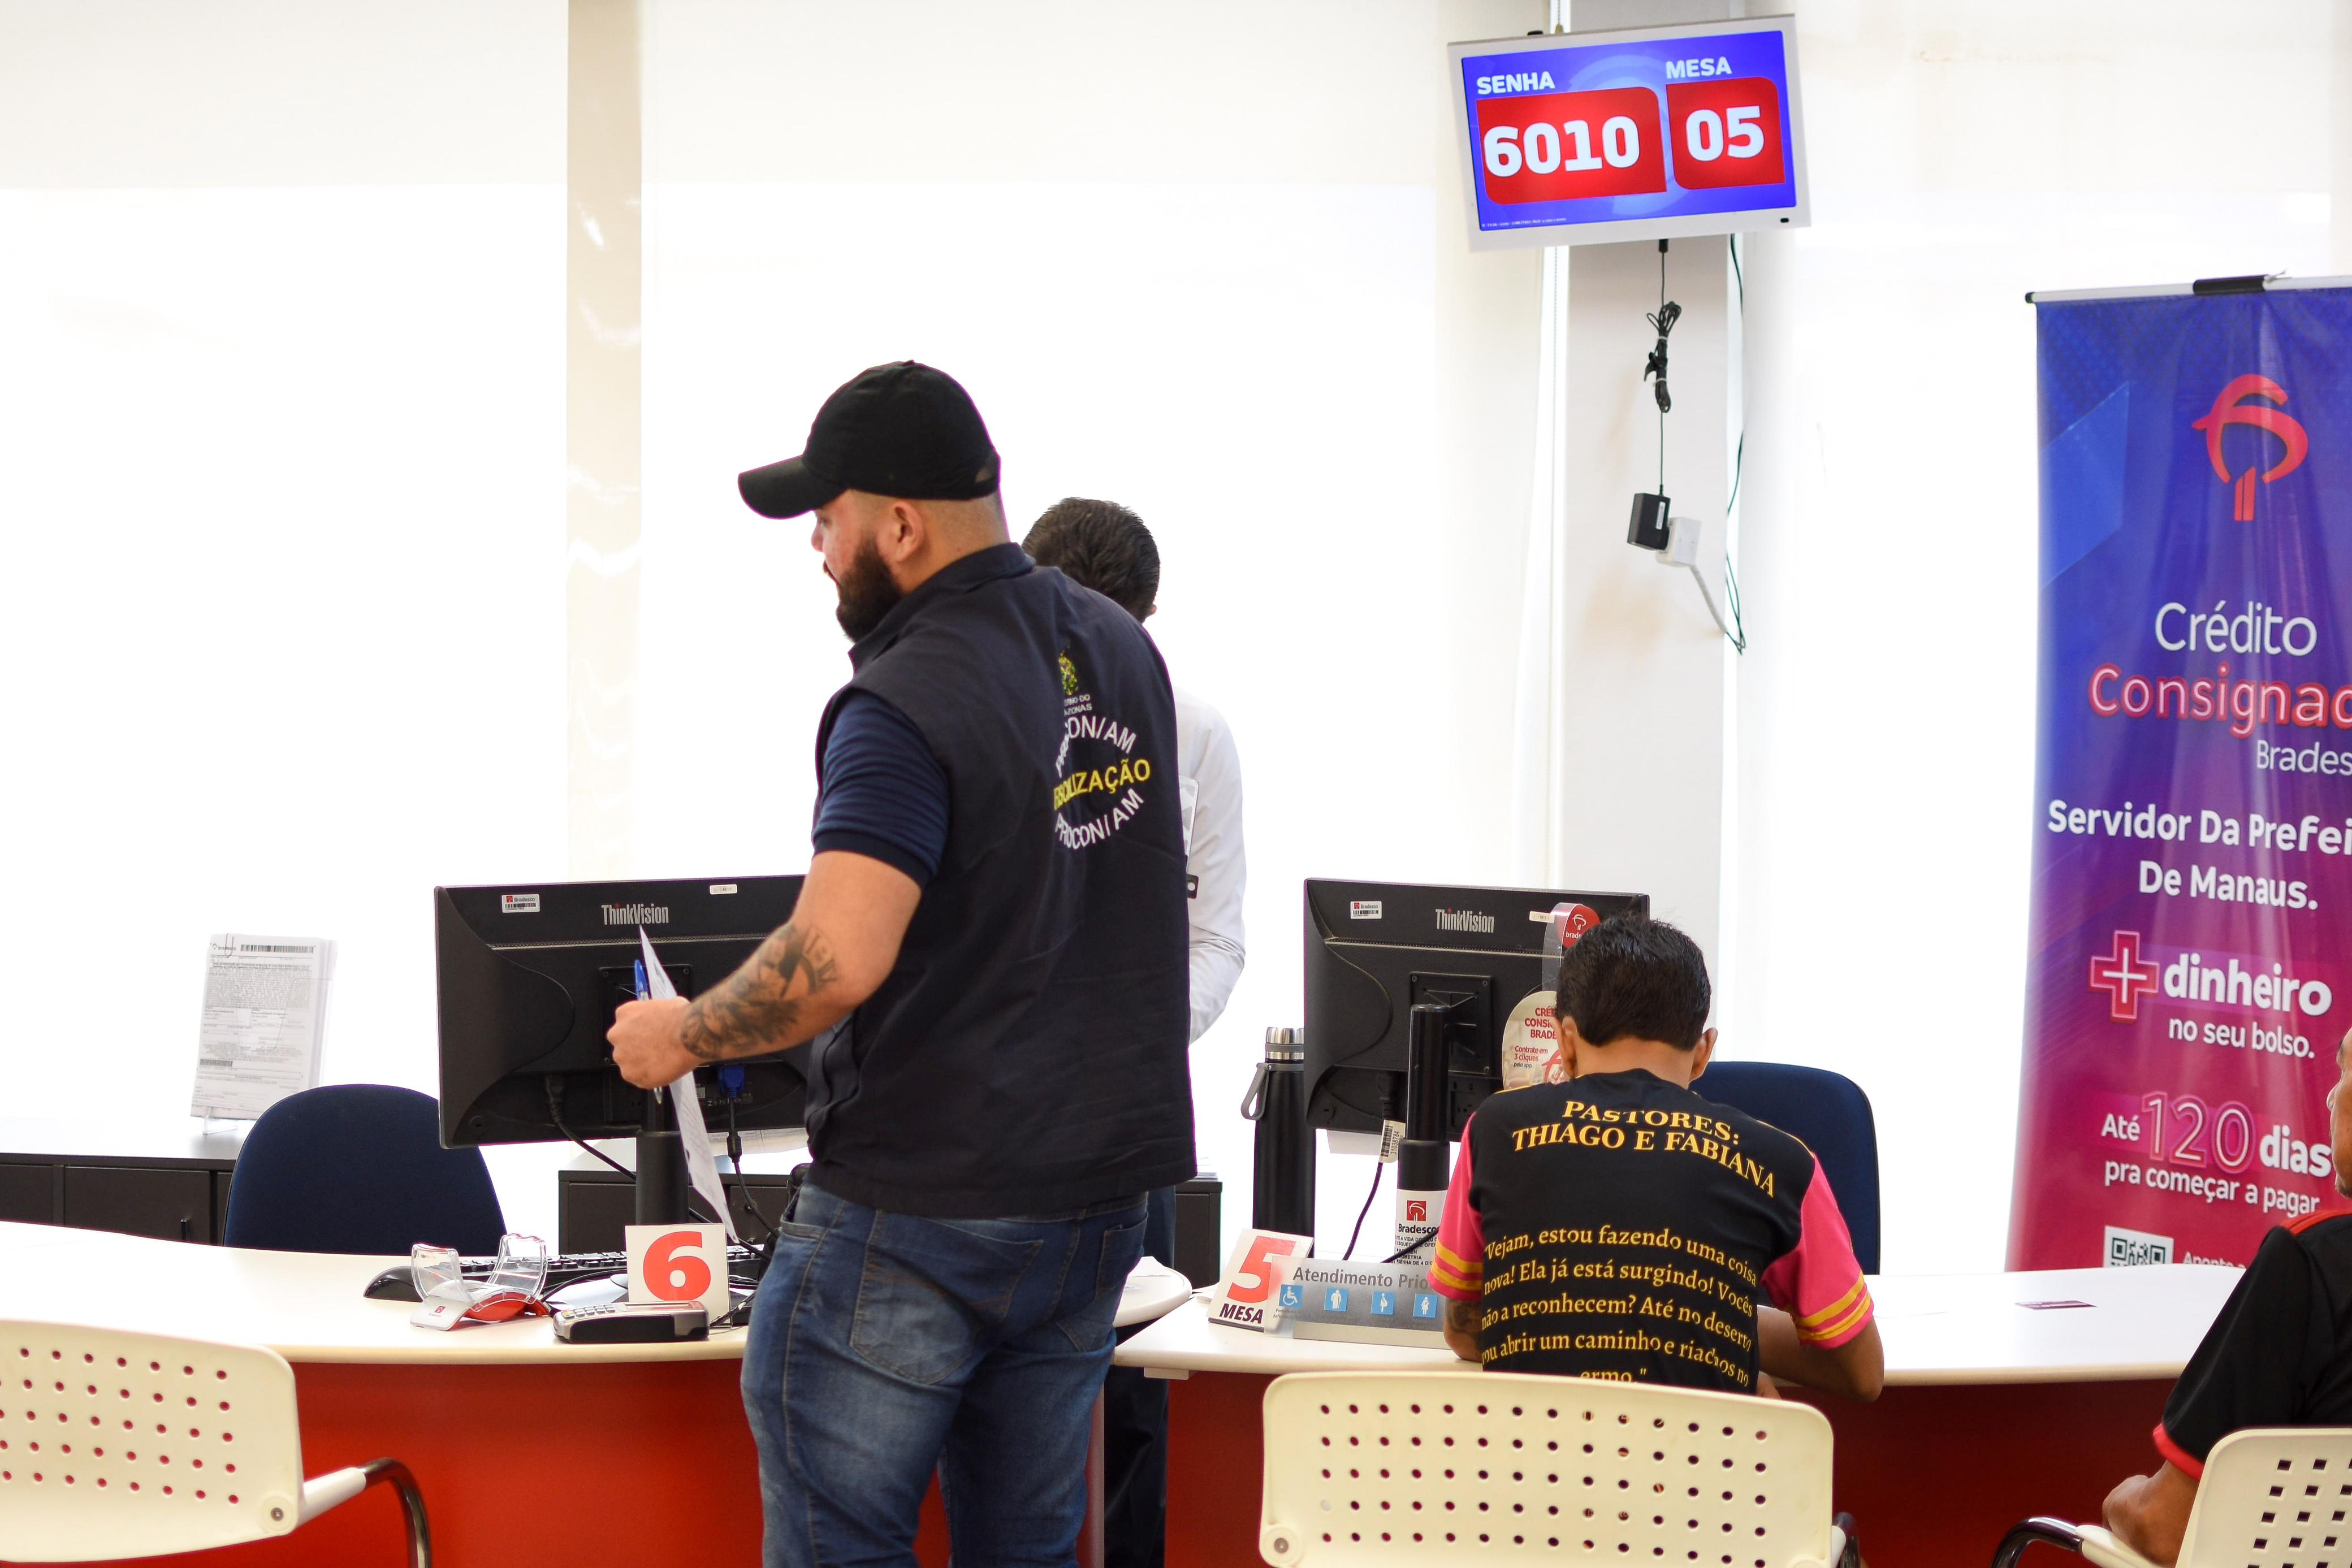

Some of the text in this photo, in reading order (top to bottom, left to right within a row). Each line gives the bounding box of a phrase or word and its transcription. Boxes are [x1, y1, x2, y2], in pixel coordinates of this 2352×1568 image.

[1476, 71, 1555, 95] SENHA
[1666, 56, 1732, 80] MESA
[1483, 115, 1640, 177] 6010
[1685, 105, 1765, 162] 05
[2155, 600, 2318, 656] Crédito
[2048, 799, 2352, 856] Servidor Da Prefei
[2139, 860, 2318, 911] De Manaus.
[601, 904, 669, 925] ThinkVision
[1435, 908, 1495, 934] ThinkVision
[2164, 952, 2333, 1016] dinheiro
[1515, 1045, 1538, 1054] Contrate
[1519, 1054, 1538, 1063] cliques
[2168, 1017, 2315, 1059] no seu bolso.
[1562, 1100, 1740, 1145] PASTORES:
[2101, 1090, 2332, 1179] Até 120 dias
[1512, 1122, 1774, 1198] THIAGO E FABIANA
[2105, 1160, 2320, 1219] pra começar a pagar
[643, 1230, 711, 1302] 6
[1227, 1235, 1296, 1303] 5
[1292, 1267, 1393, 1288] Atendimento
[1538, 1227, 1593, 1244] estou
[1598, 1224, 1681, 1250] fazendo
[1686, 1239, 1725, 1266] uma
[1728, 1258, 1757, 1287] coisa
[1219, 1302, 1263, 1324] MESA
[1484, 1258, 1753, 1318] nova! Ela já está surgindo! Vocês
[1482, 1292, 1752, 1352] não a reconhecem? Até no deserto
[1500, 1332, 1536, 1357] abrir
[1540, 1335, 1570, 1350] um
[1575, 1329, 1661, 1351] caminho
[1664, 1340, 1675, 1355] e
[1679, 1340, 1736, 1377] riachos
[1737, 1368, 1749, 1387] no
